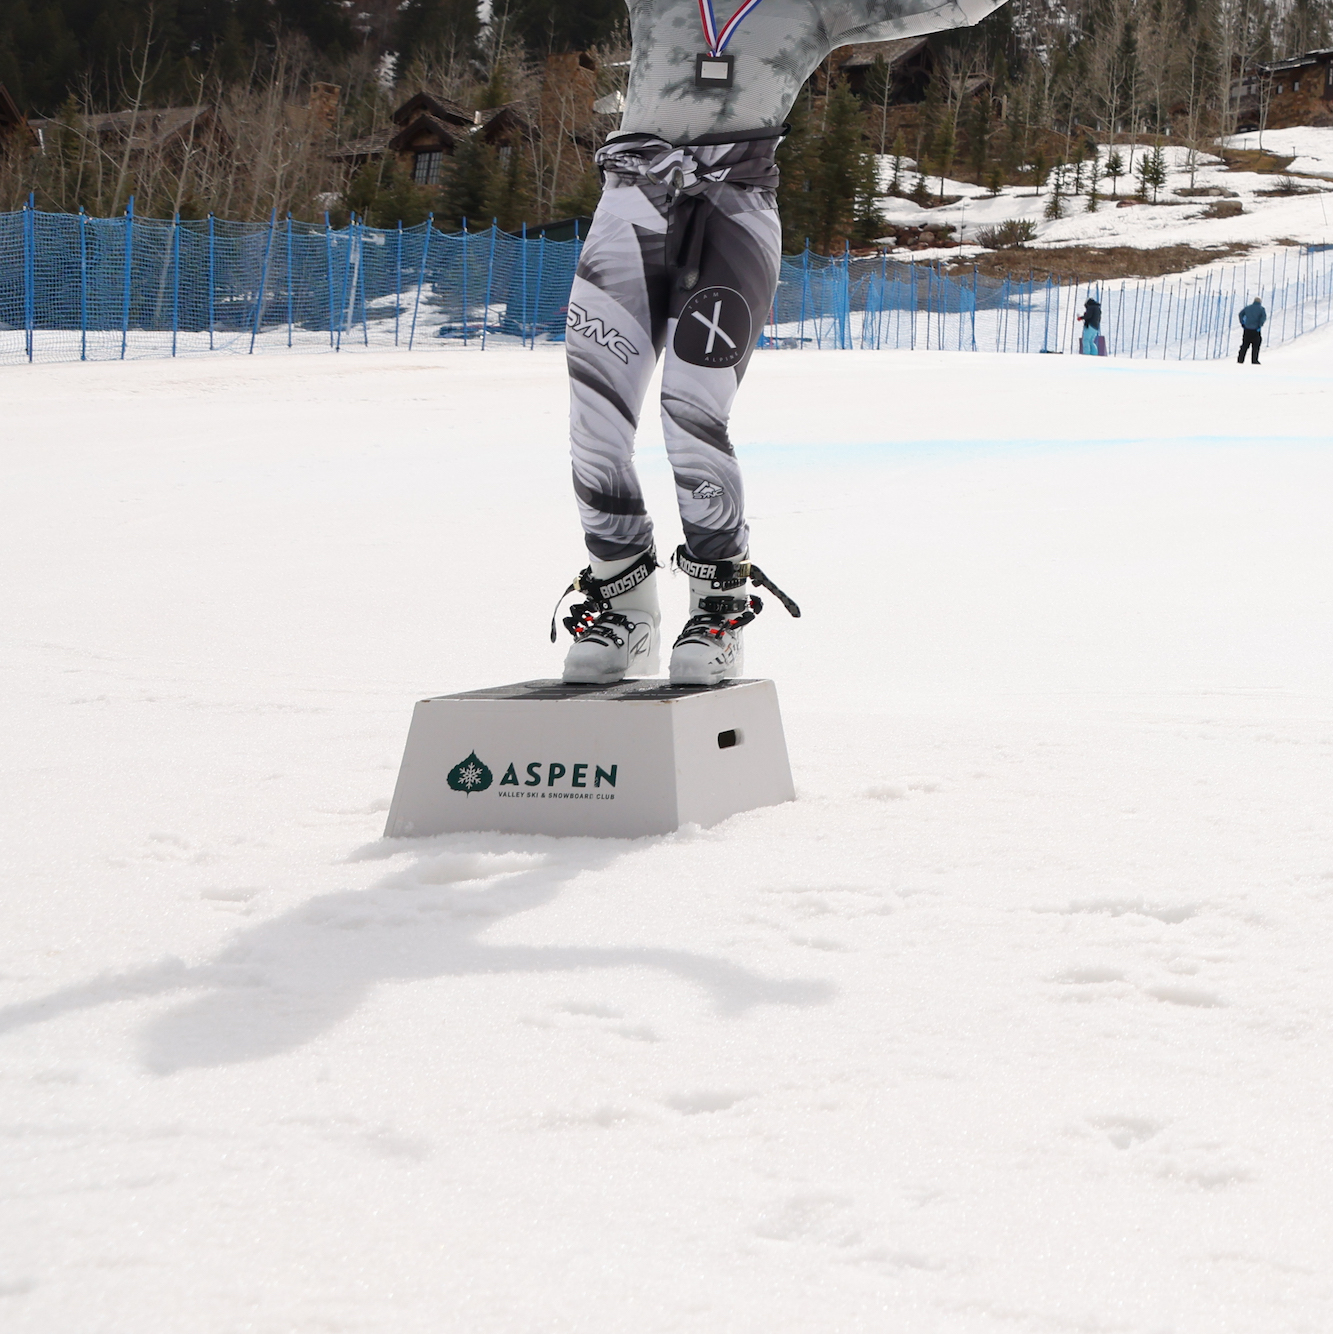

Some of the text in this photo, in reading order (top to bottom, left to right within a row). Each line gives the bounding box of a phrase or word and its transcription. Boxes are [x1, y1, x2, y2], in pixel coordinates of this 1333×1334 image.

[688, 291, 720, 310] TEAM
[566, 301, 639, 365] SYNC
[704, 351, 739, 363] ALPINE
[679, 554, 717, 580] BOOSTER
[600, 564, 649, 600] BOOSTER
[499, 762, 618, 788] ASPEN
[548, 792, 594, 800] SNOWBOARD
